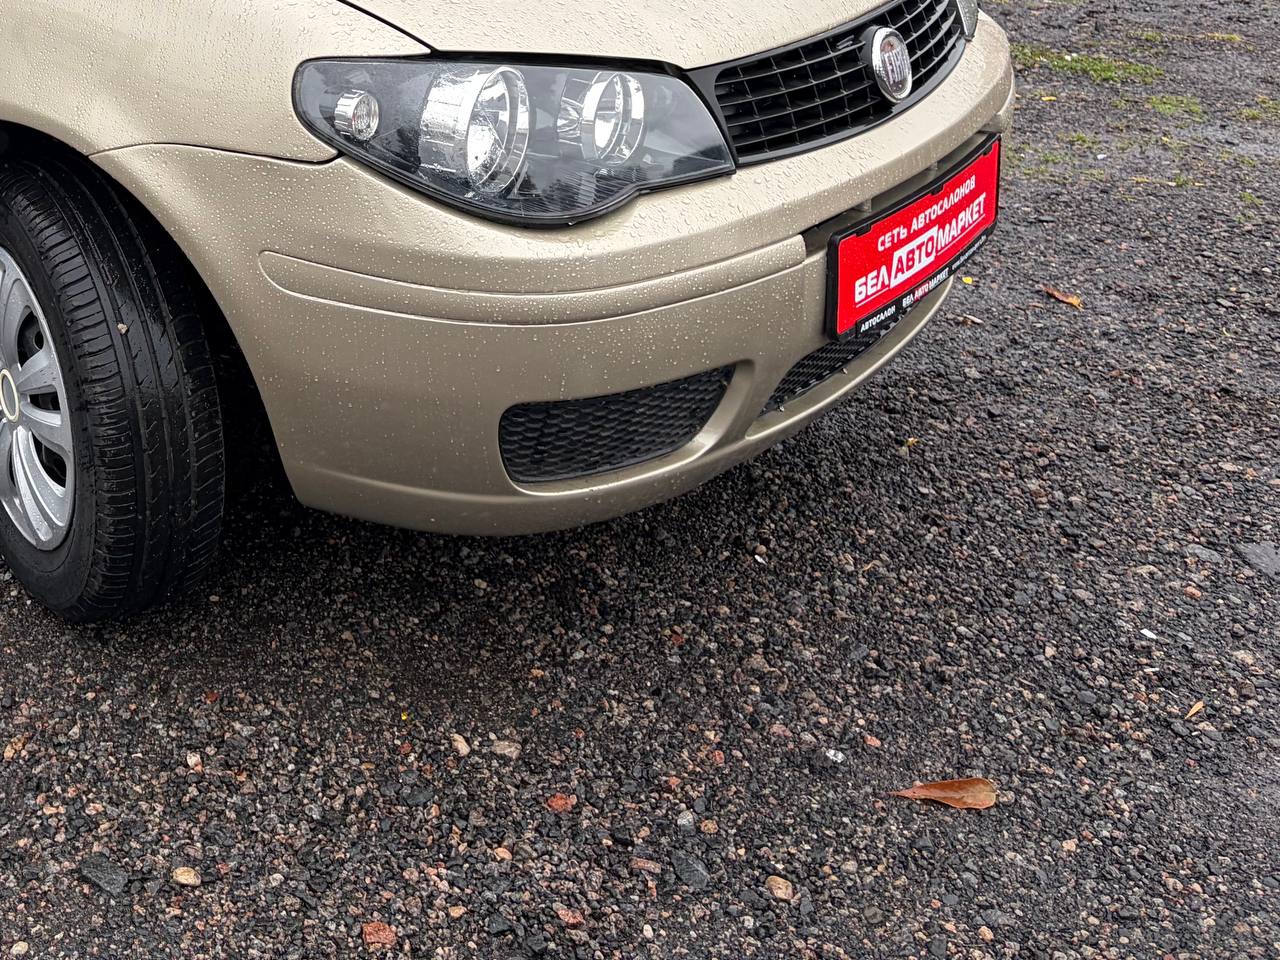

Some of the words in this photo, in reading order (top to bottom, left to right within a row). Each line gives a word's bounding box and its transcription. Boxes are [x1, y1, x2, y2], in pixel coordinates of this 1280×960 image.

[878, 226, 907, 251] СЕТЬ
[910, 175, 975, 234] АВТОСАЛОНОВ
[860, 305, 896, 332] АВТОСАЛОН
